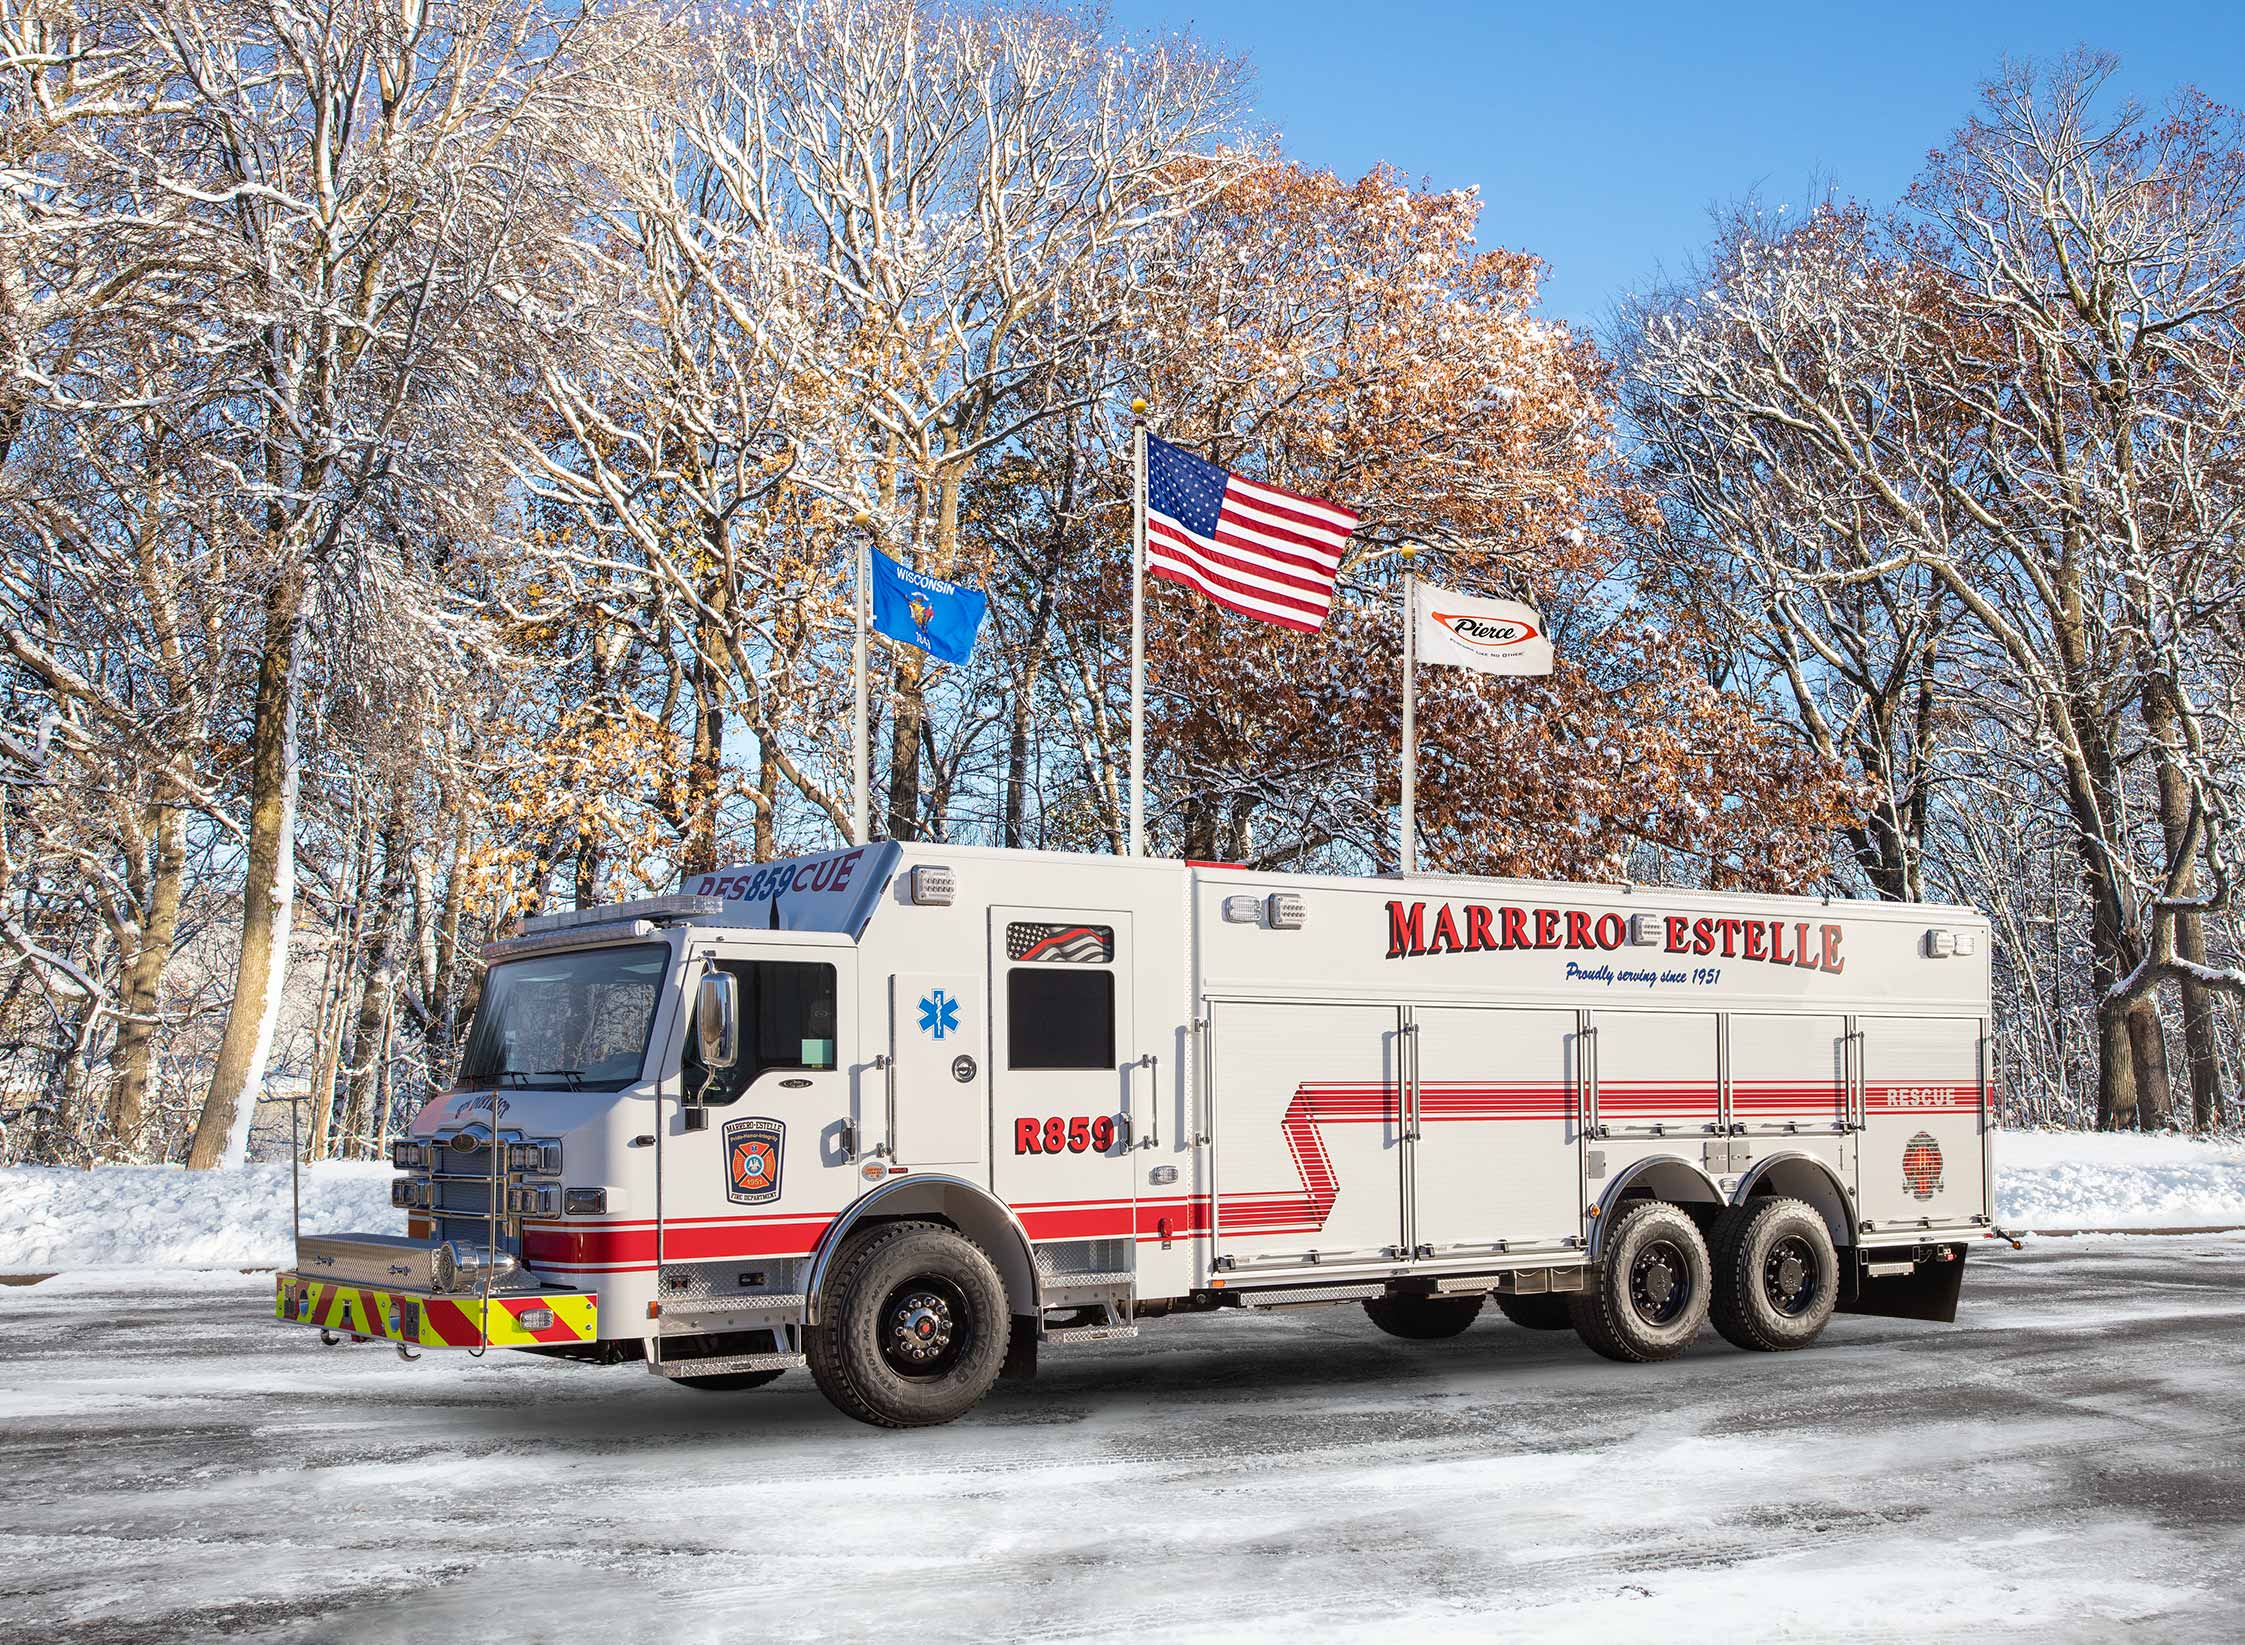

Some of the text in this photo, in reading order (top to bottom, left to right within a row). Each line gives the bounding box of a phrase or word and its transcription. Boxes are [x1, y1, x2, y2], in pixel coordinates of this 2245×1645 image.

[896, 566, 956, 596] WISCONSIN
[1454, 618, 1515, 640] Pierce
[1385, 900, 1845, 975] MARRERO ESTELLE
[1566, 961, 1721, 988] Proudly serving since 1951
[1887, 1088, 1956, 1106] RESCUE
[1014, 1116, 1115, 1155] R859
[747, 1178, 763, 1186] 1951
